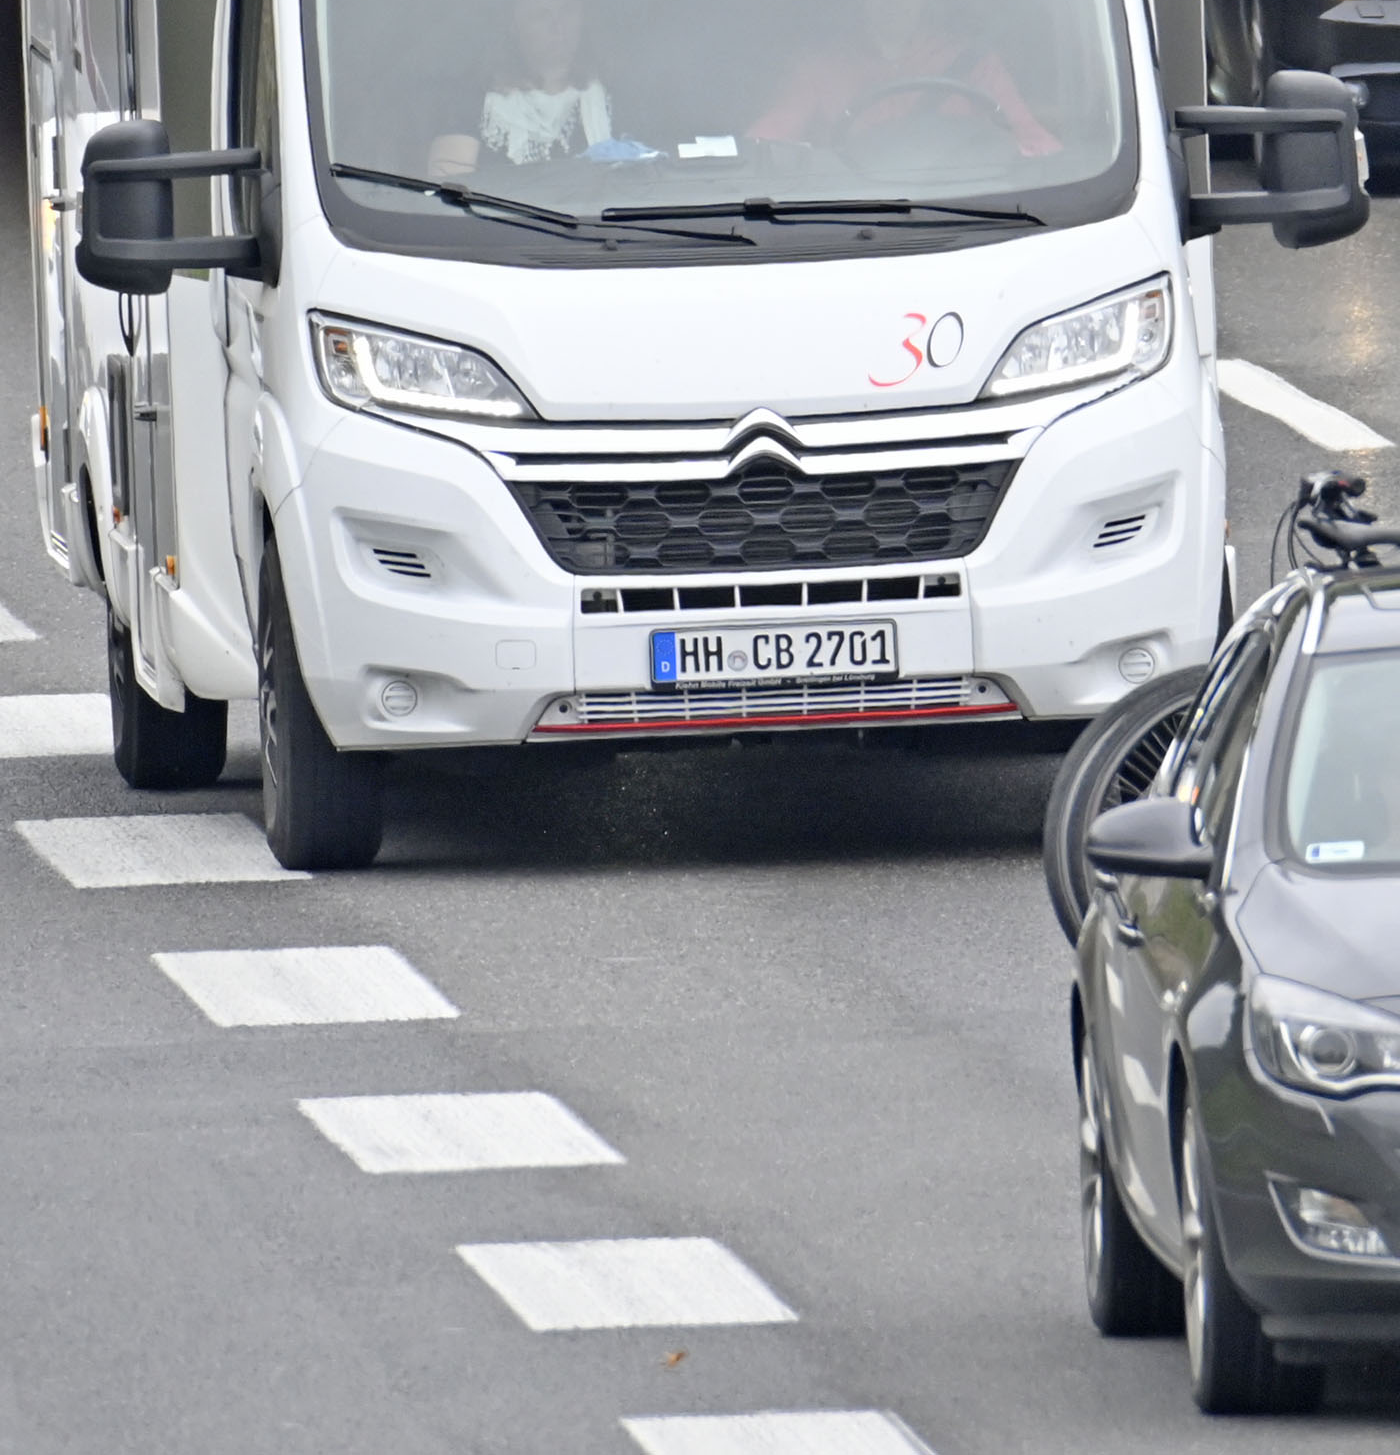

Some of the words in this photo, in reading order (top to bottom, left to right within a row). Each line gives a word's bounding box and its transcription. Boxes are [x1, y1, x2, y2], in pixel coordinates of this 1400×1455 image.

[868, 311, 964, 387] 30
[661, 661, 671, 673] D
[679, 635, 725, 674] HH
[752, 633, 794, 670] CB
[804, 629, 891, 669] 2701
